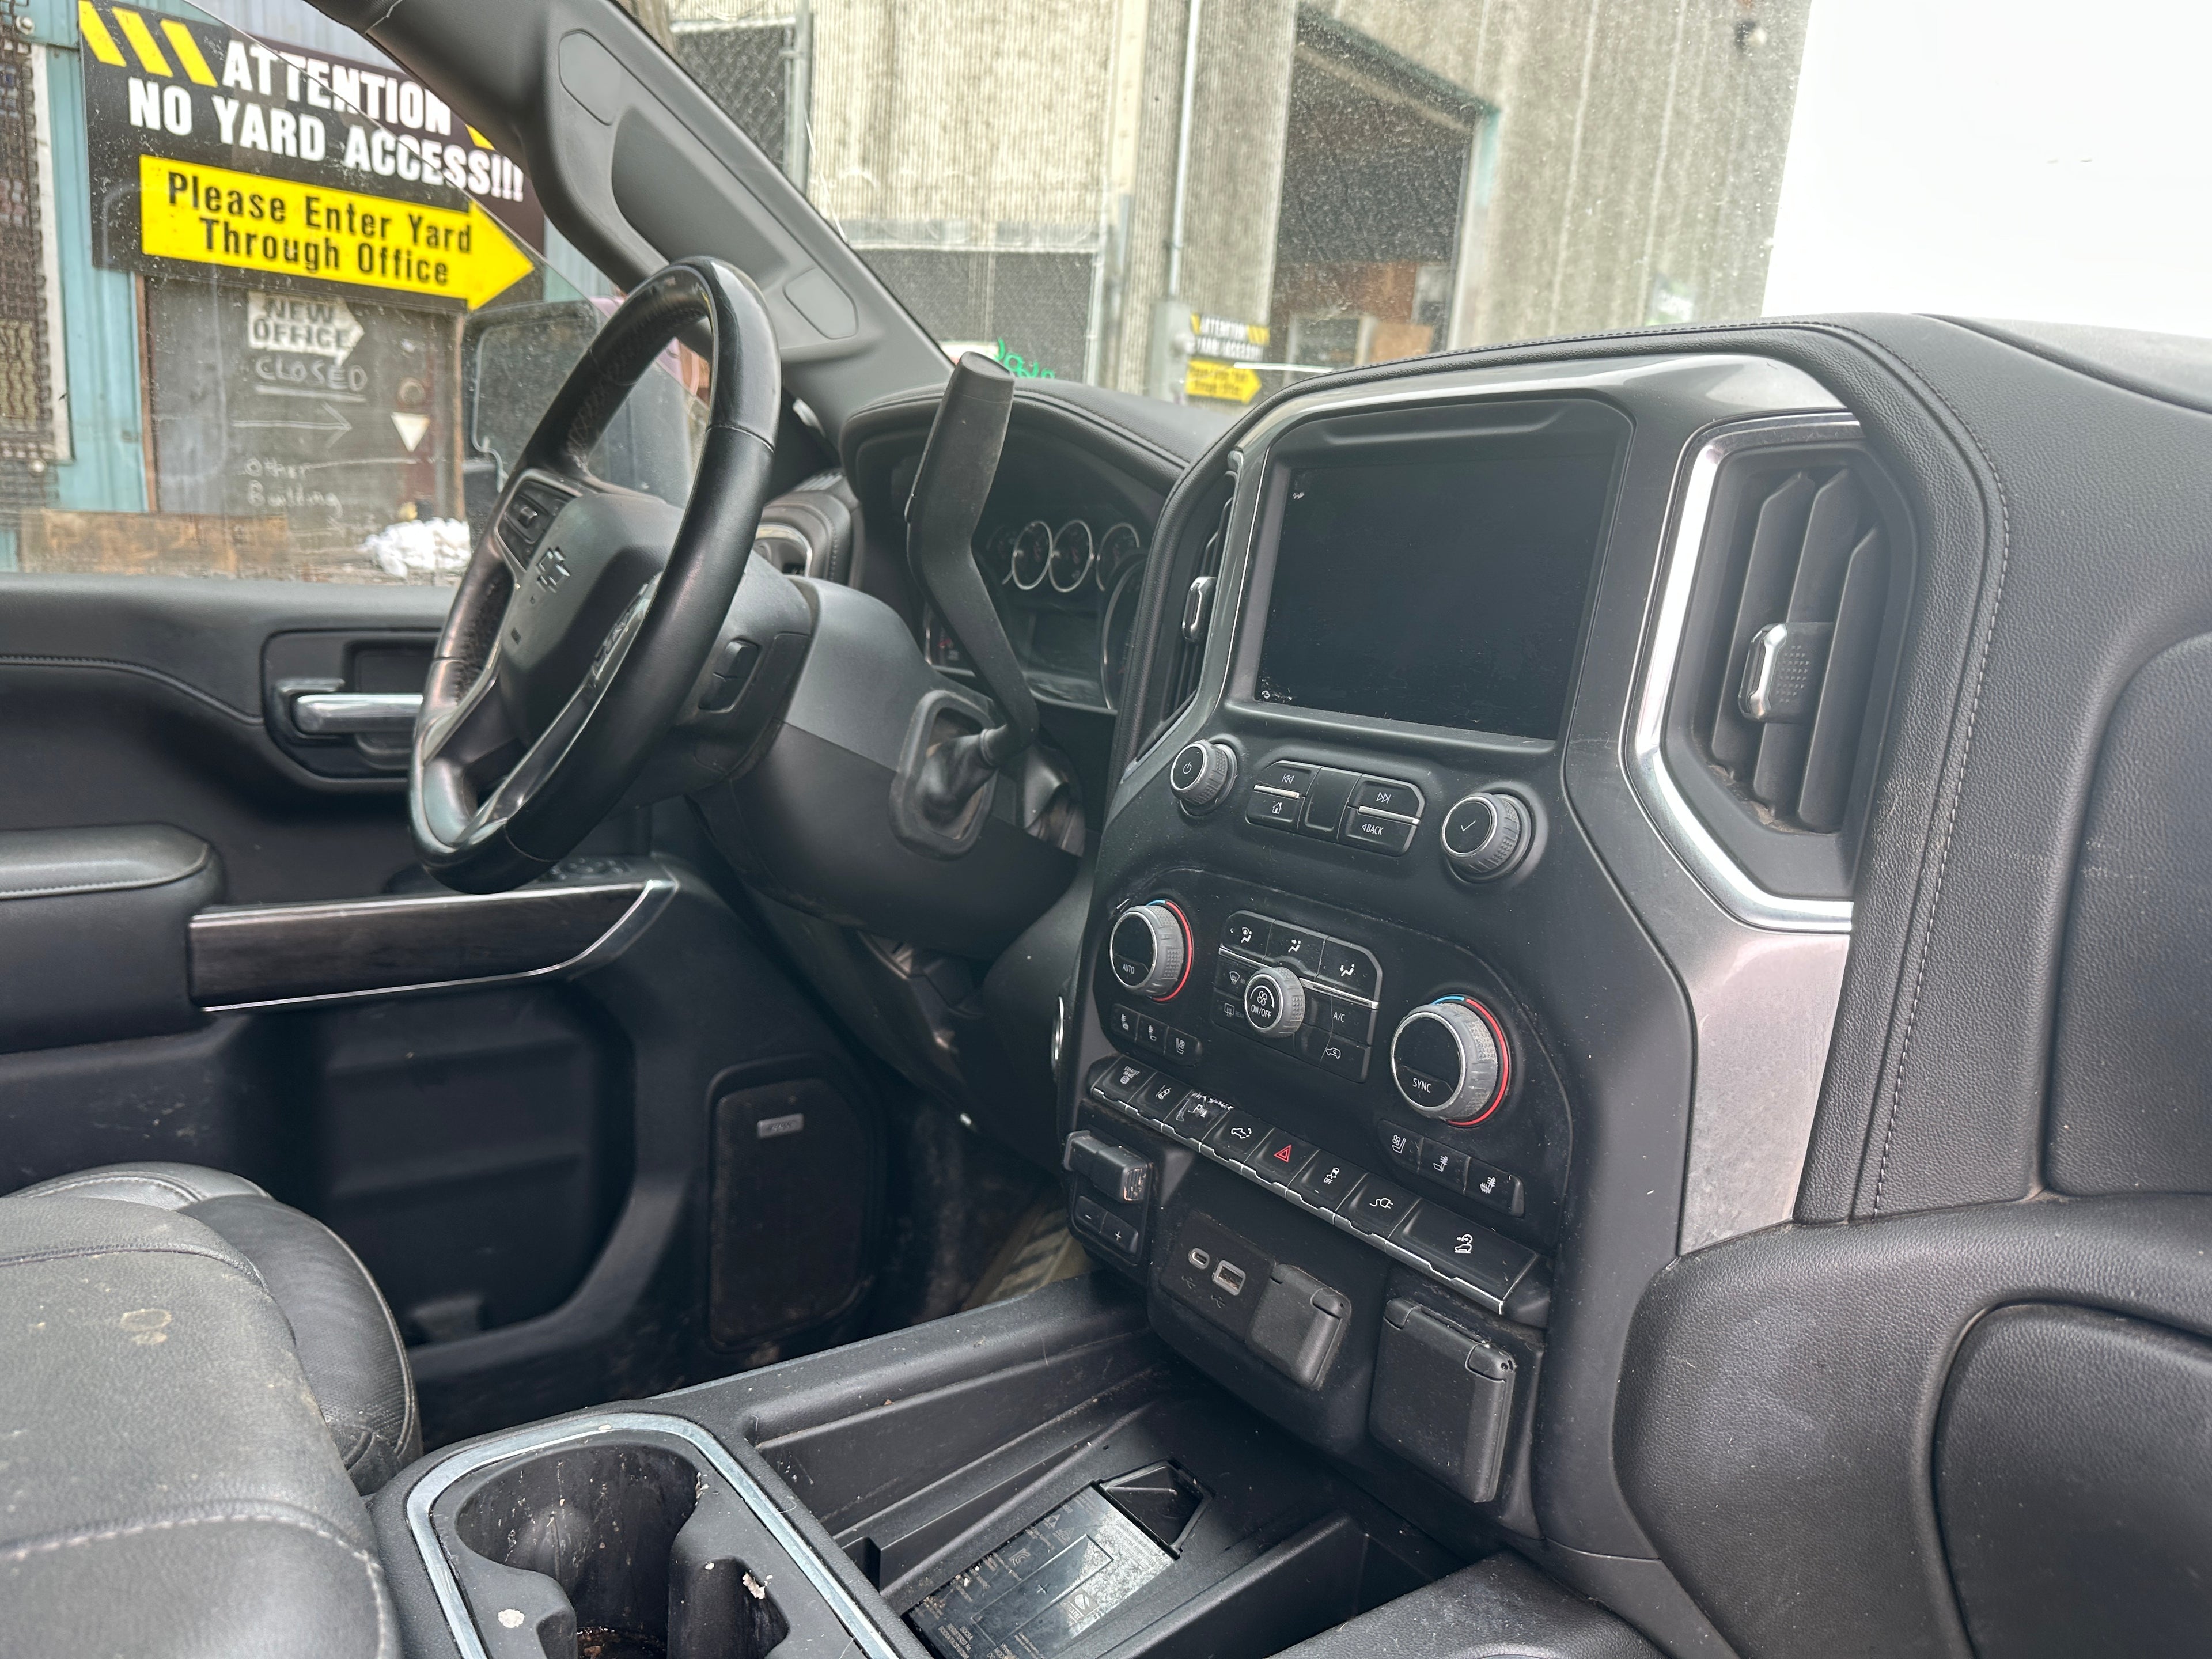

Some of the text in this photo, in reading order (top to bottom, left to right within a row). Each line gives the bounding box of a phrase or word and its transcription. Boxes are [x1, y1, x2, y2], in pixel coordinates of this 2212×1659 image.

[222, 40, 451, 136] ATTENTION
[128, 76, 524, 202] NO YARD ACCESS!!!
[168, 171, 471, 253] Please Enter Yard
[199, 217, 449, 285] Through Office
[266, 296, 334, 324] NEW
[253, 317, 349, 349] OFFICE
[255, 355, 368, 392] CLOSED
[1366, 824, 1384, 836] BACK
[1123, 963, 1135, 974] AUTO
[1251, 1004, 1272, 1019] ON/OFF
[1333, 1011, 1346, 1023] A/C
[1412, 1077, 1432, 1093] SYNC
